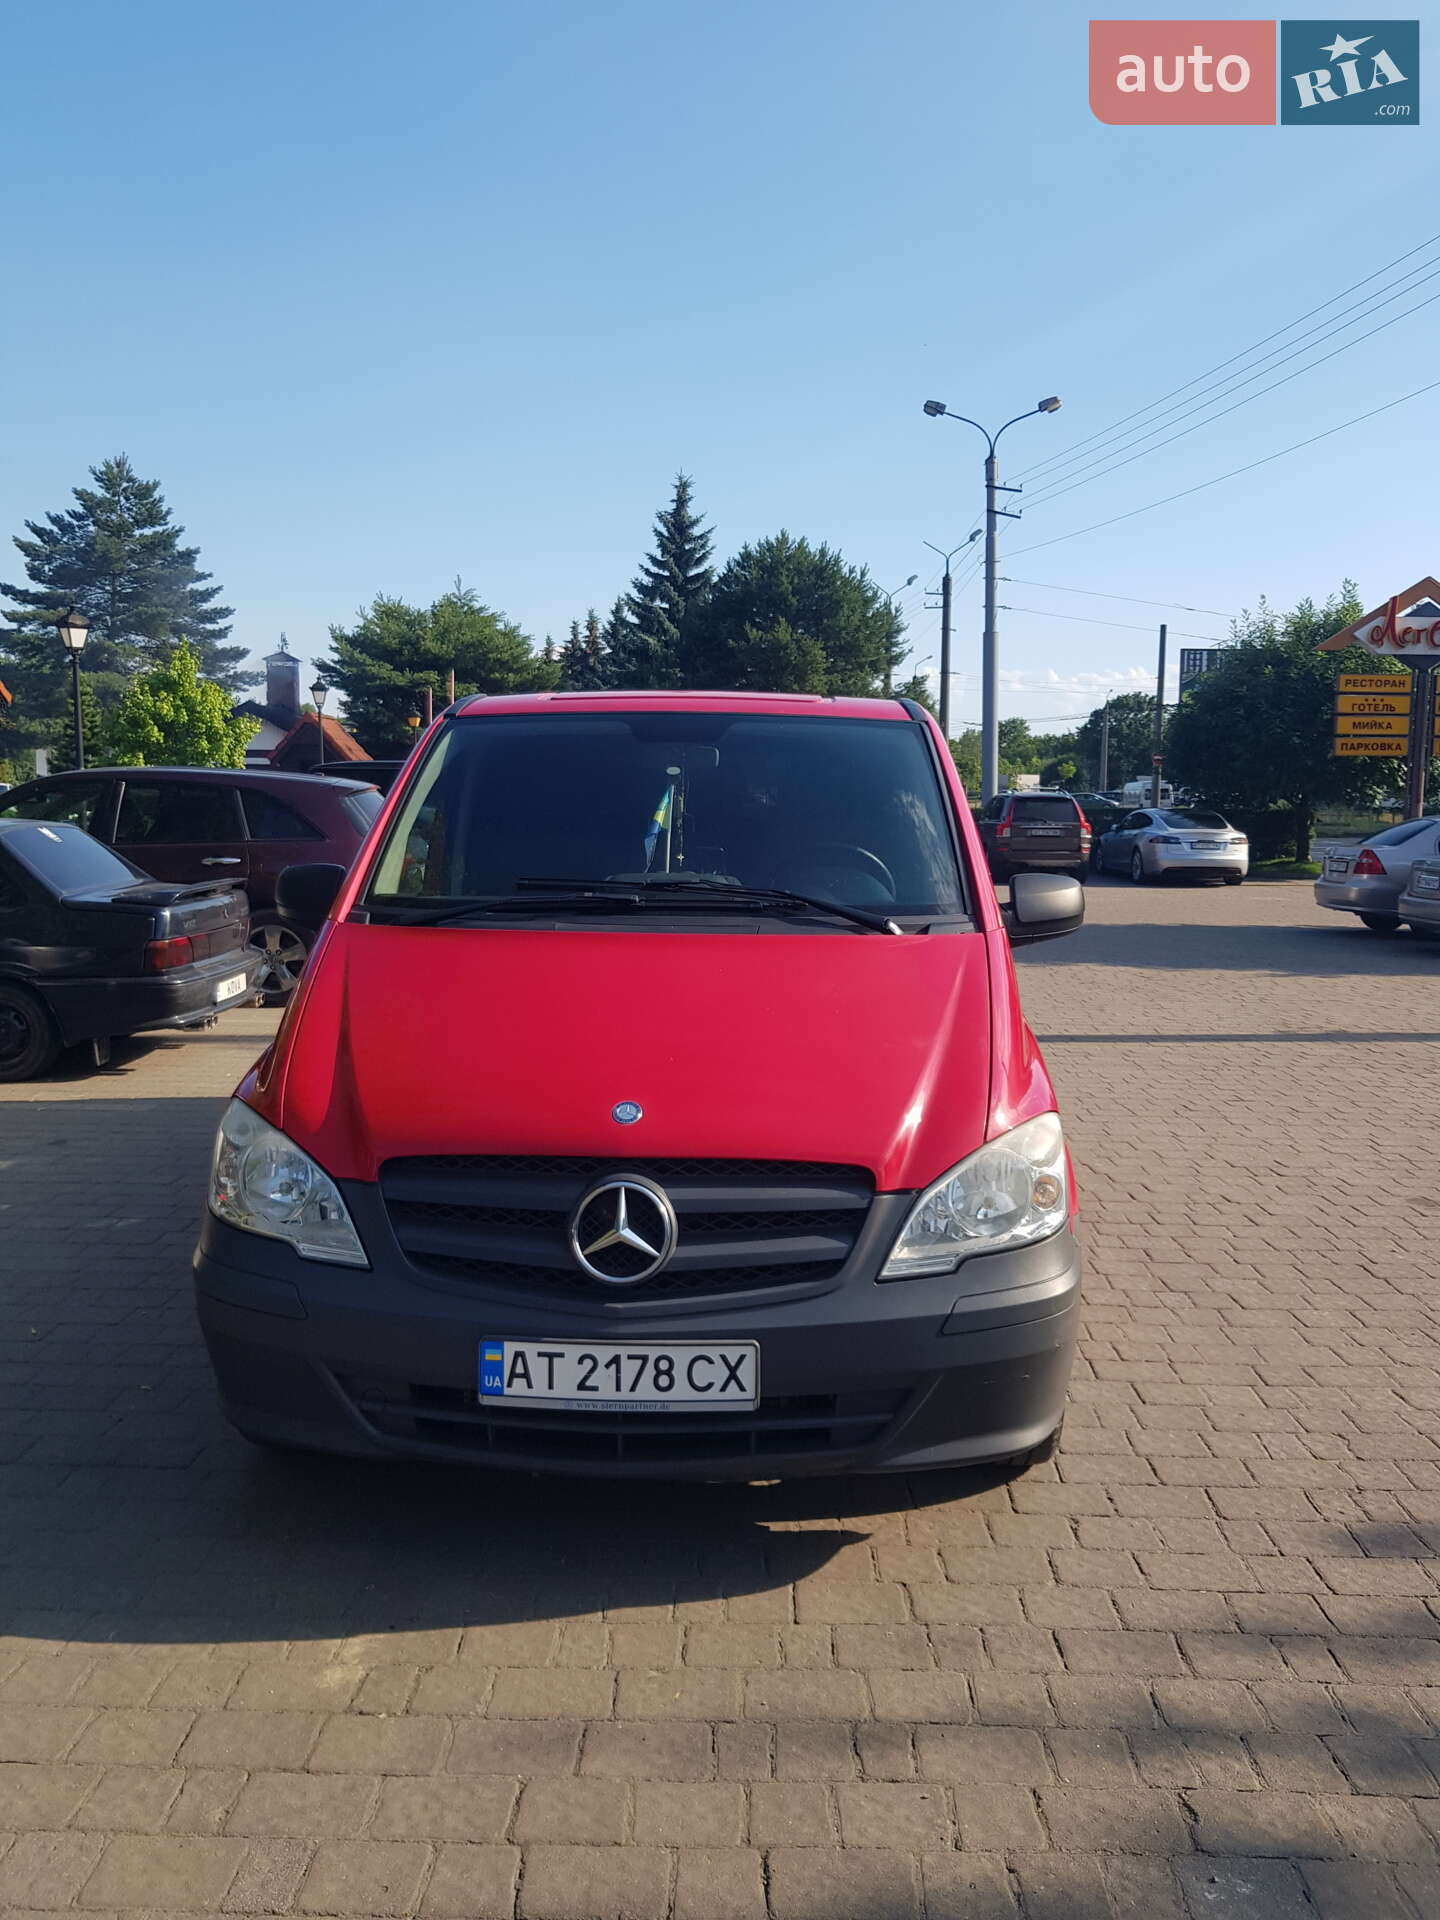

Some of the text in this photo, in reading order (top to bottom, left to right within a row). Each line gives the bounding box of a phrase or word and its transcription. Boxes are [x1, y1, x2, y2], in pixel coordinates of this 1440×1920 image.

[1344, 679, 1406, 688] РЕСТОРАН
[1351, 703, 1396, 712] ГОТЕЛЬ
[1352, 719, 1393, 730] МИЙКА
[1340, 742, 1402, 751] ПАРКОВКА
[506, 1351, 747, 1393] AT 2178 CX
[485, 1375, 502, 1388] UA
